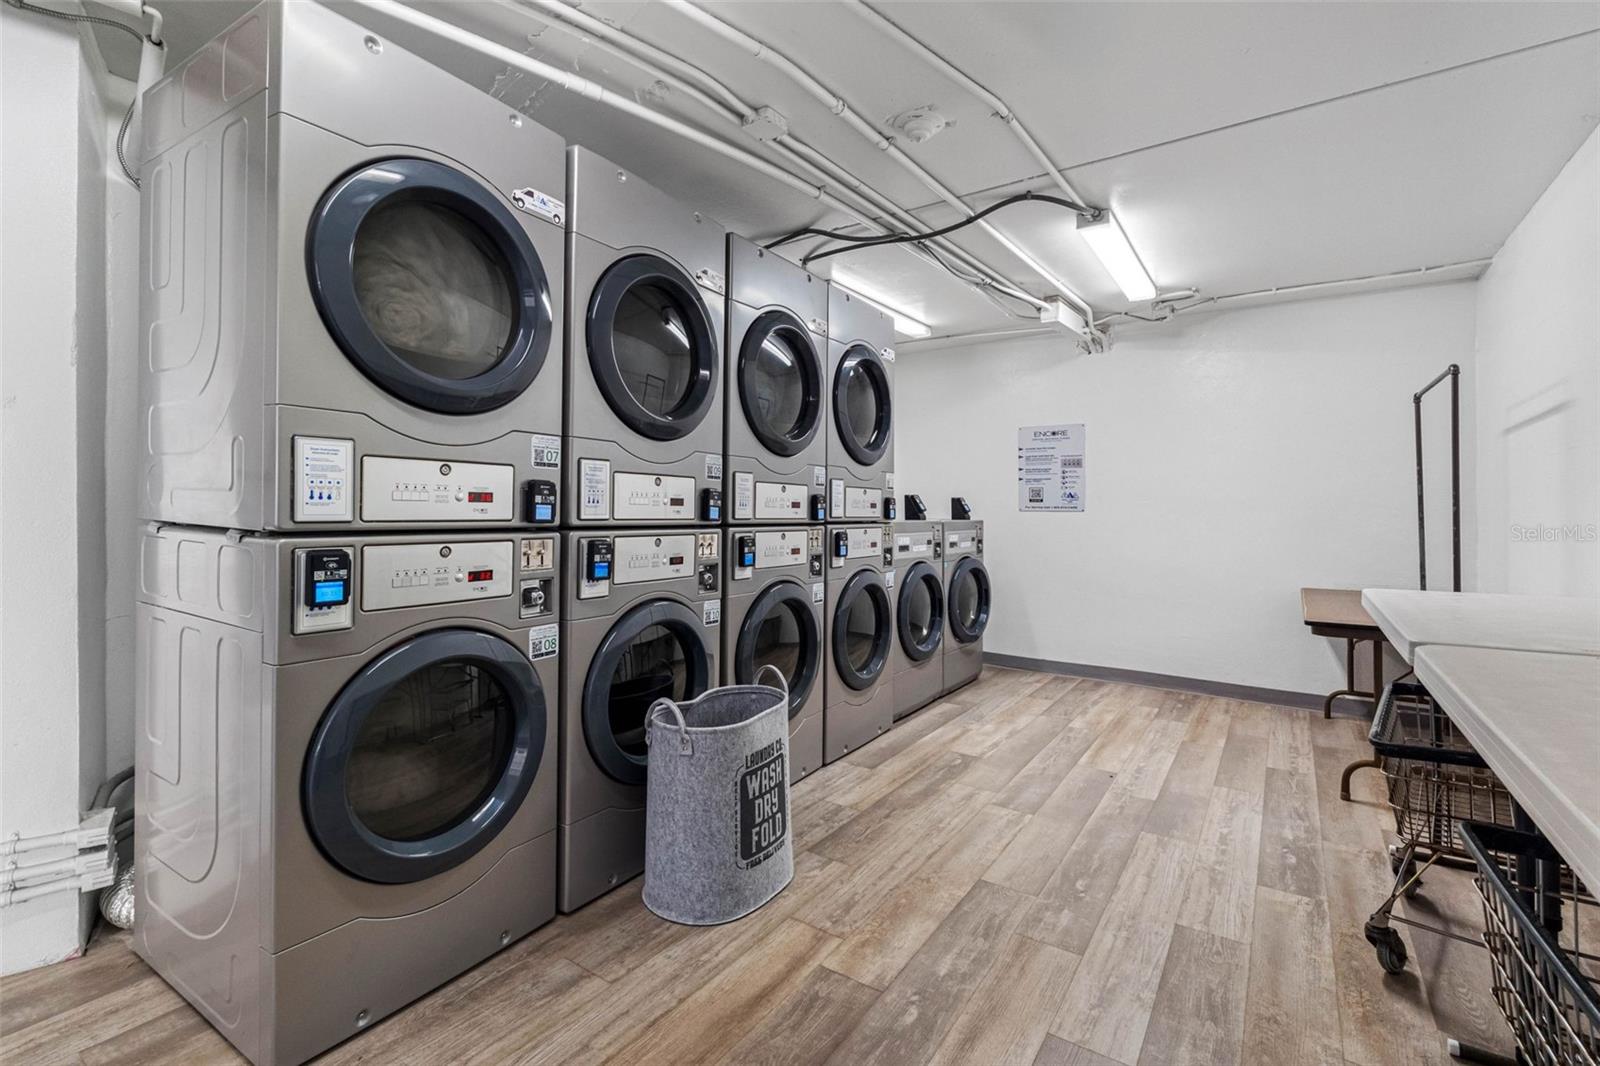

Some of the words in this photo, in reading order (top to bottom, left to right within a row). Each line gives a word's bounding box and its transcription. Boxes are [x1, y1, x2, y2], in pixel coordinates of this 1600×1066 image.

[1033, 430, 1068, 438] ENCORE
[546, 450, 559, 461] 07
[543, 637, 557, 651] 08
[745, 741, 775, 770] LAUNDRY
[746, 758, 783, 800] WASH
[754, 787, 779, 825] DRY
[751, 812, 783, 854] FOLD
[745, 855, 763, 871] FREE
